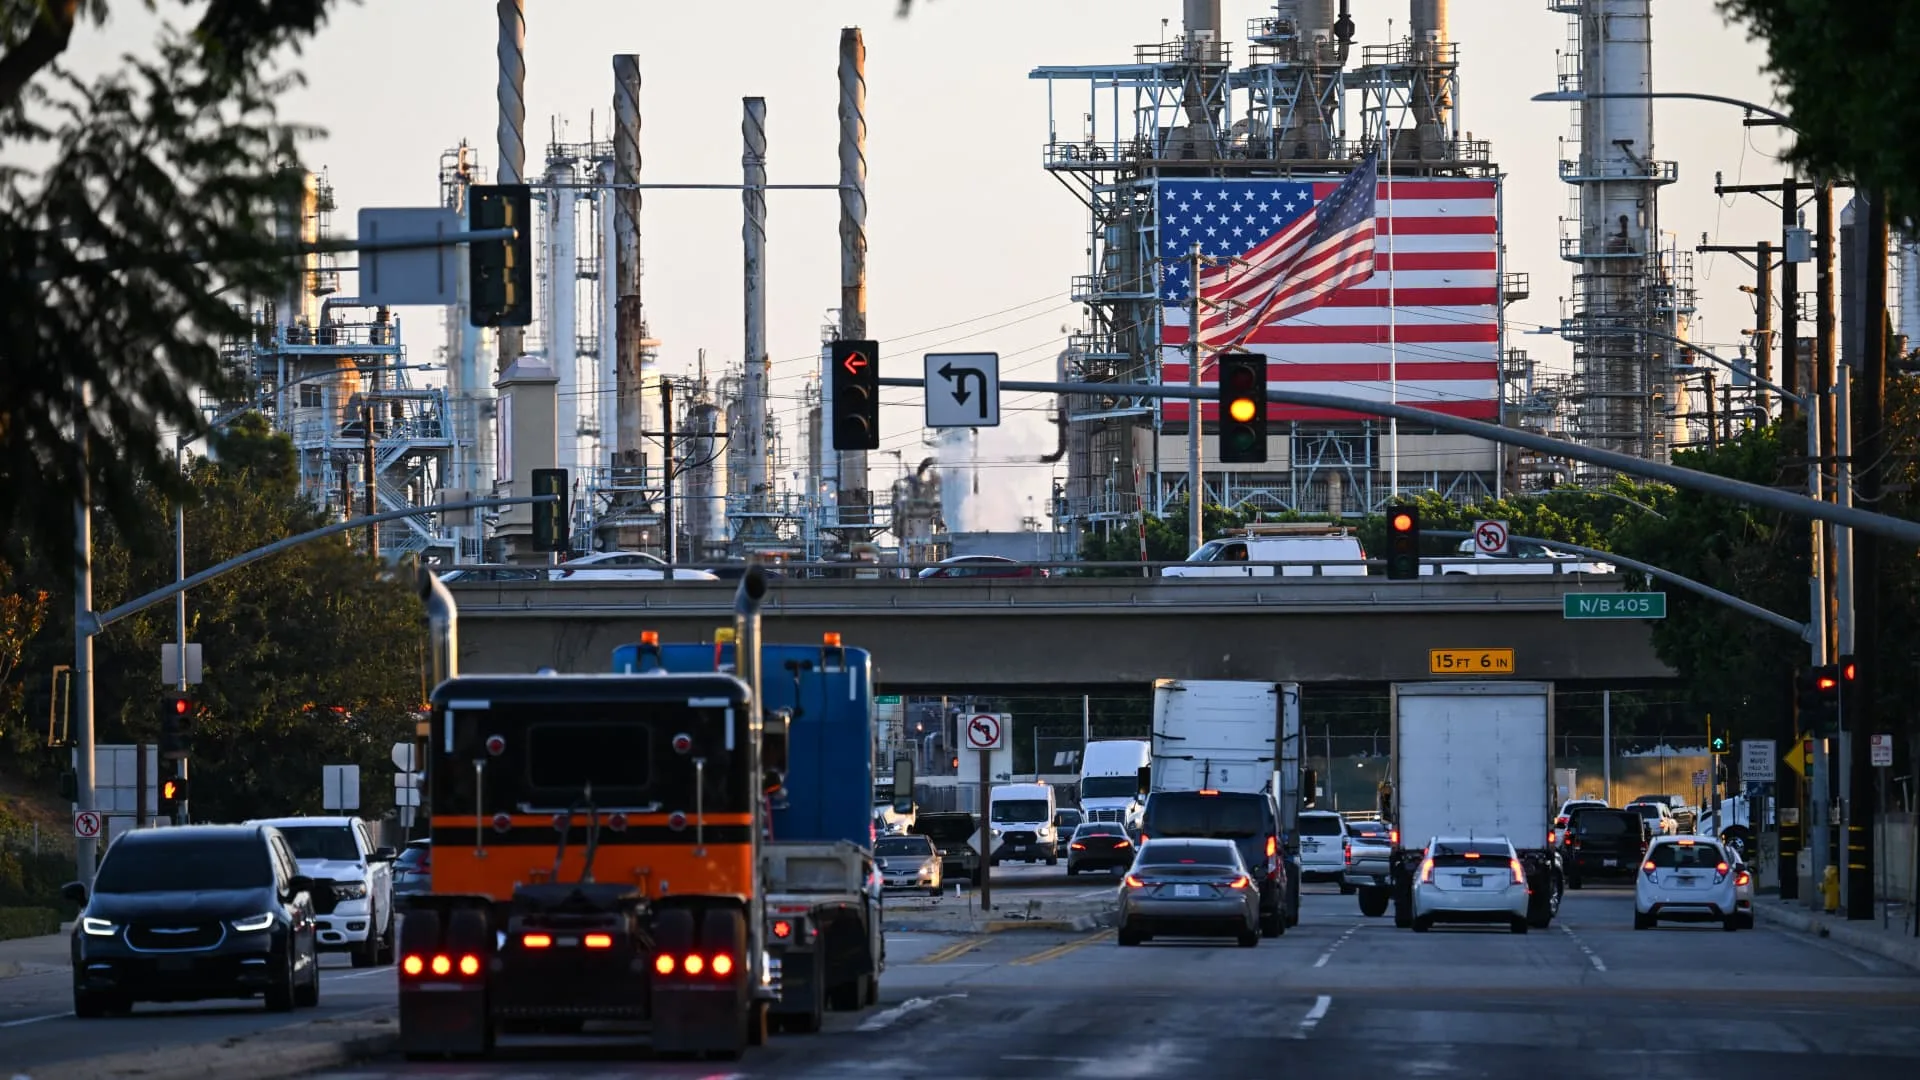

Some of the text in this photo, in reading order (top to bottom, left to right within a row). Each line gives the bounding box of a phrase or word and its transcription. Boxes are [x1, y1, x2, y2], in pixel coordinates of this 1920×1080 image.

[1580, 598, 1650, 613] N/B 405
[1436, 654, 1508, 668] 15 FT 6 IN
